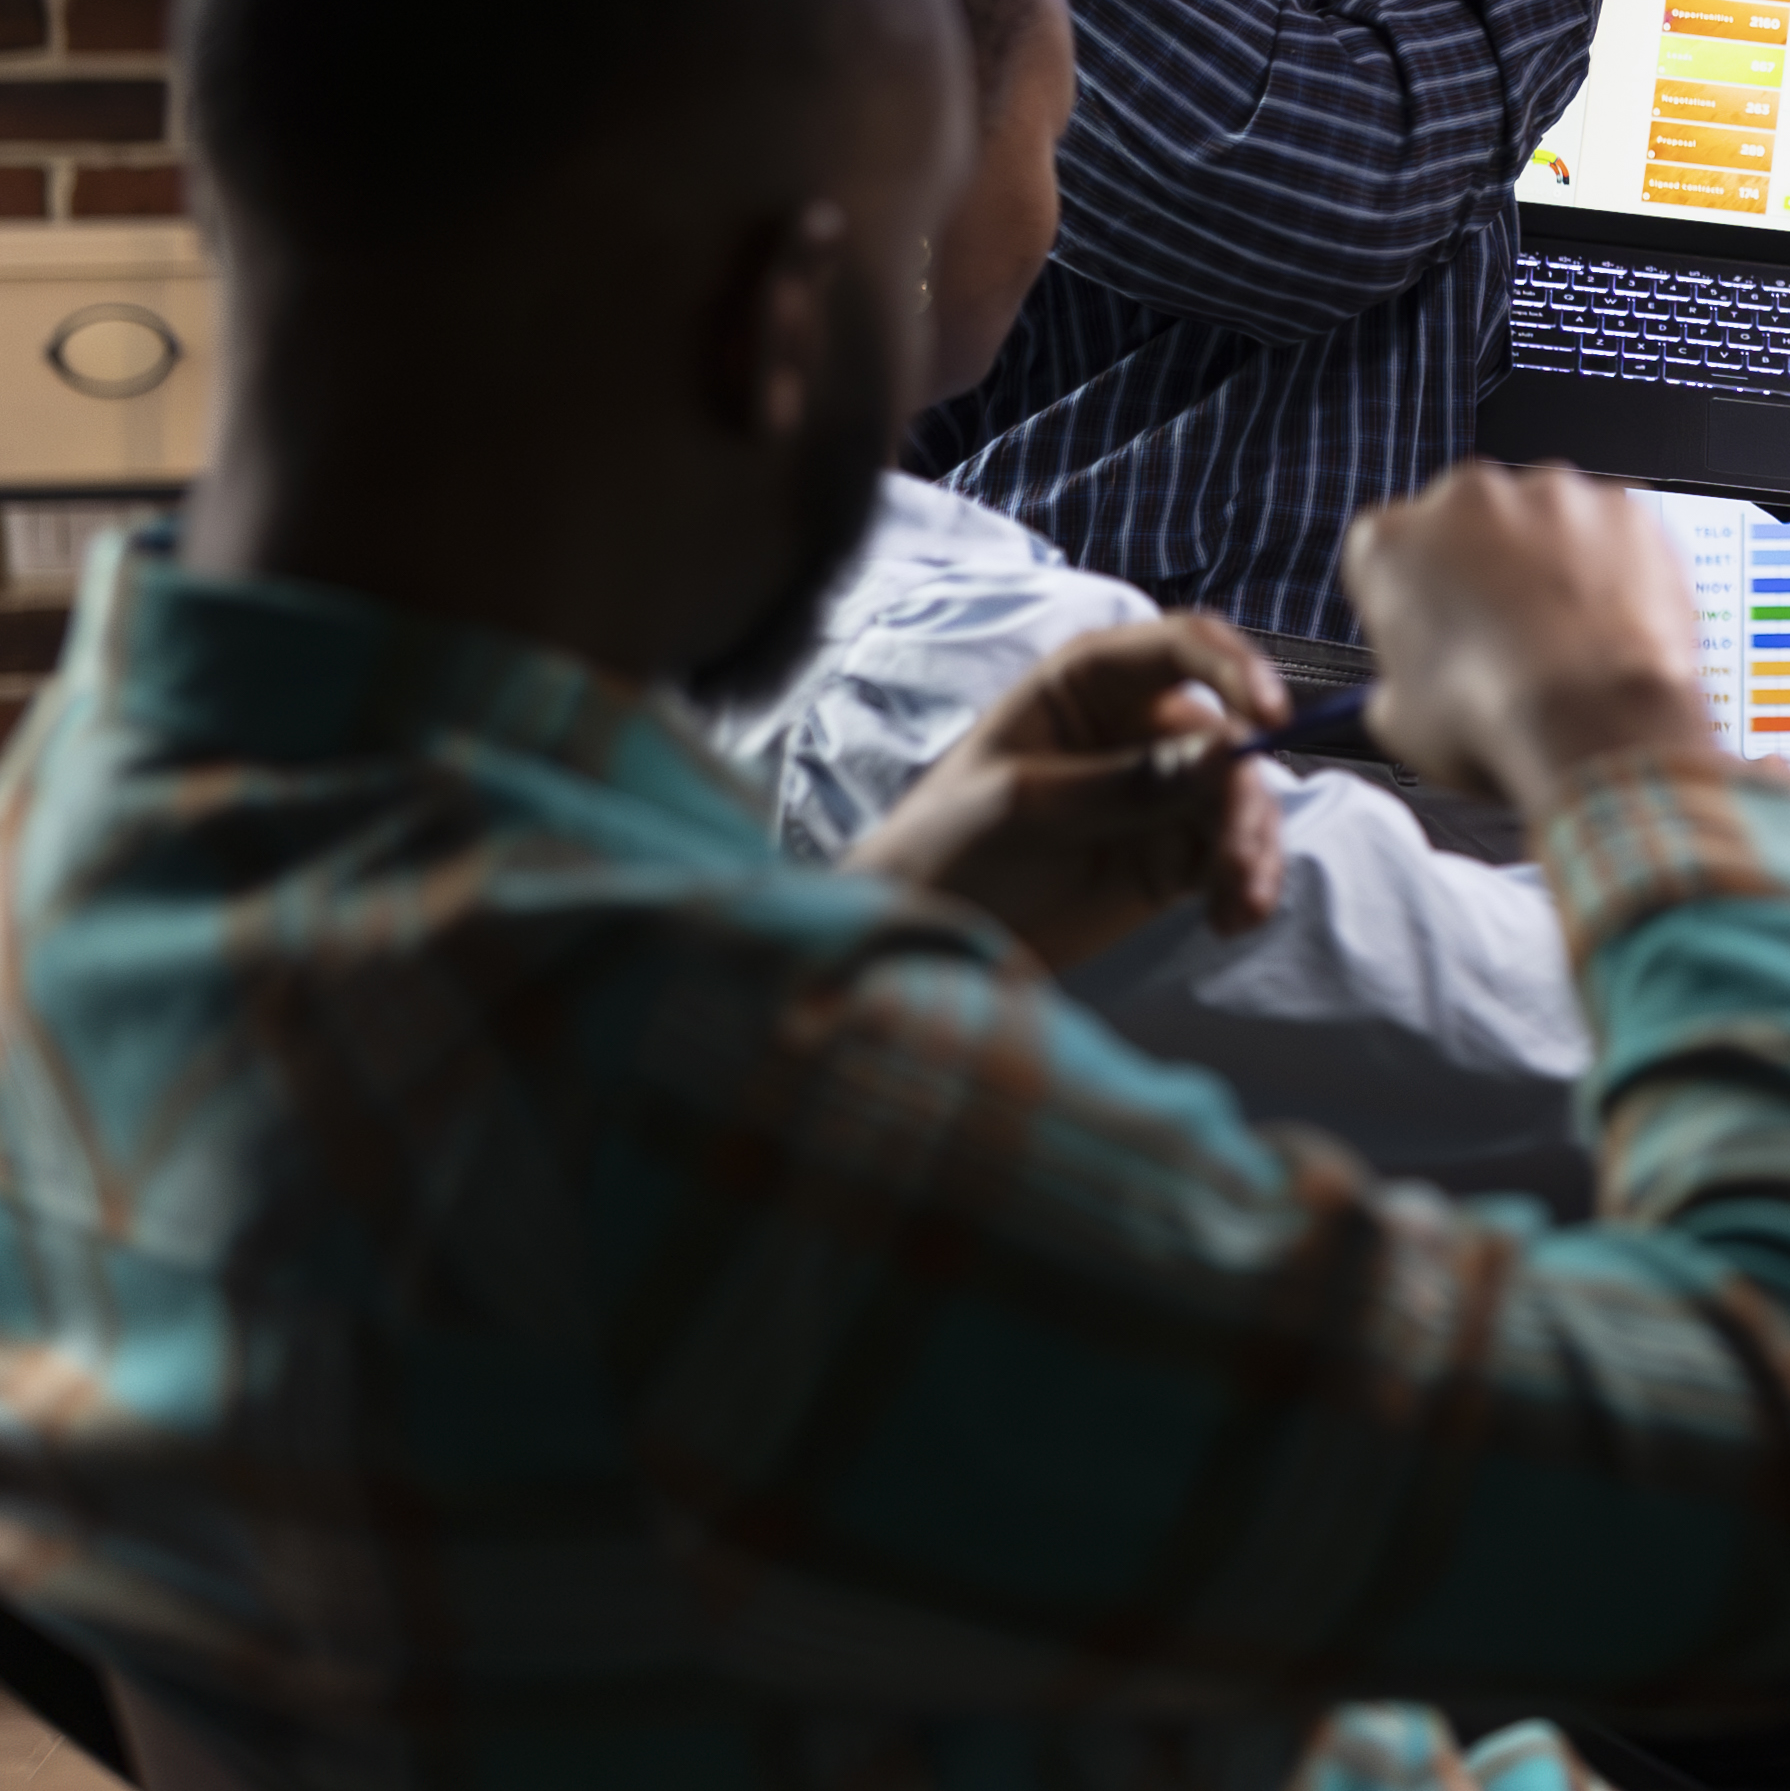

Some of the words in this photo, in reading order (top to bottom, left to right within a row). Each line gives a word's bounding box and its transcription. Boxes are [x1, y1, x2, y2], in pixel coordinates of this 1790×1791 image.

[1671, 8, 1734, 24] Opportunities
[1656, 135, 1697, 148] Proposal
[1649, 178, 1680, 192] Signed
[1681, 181, 1724, 195] contracts
